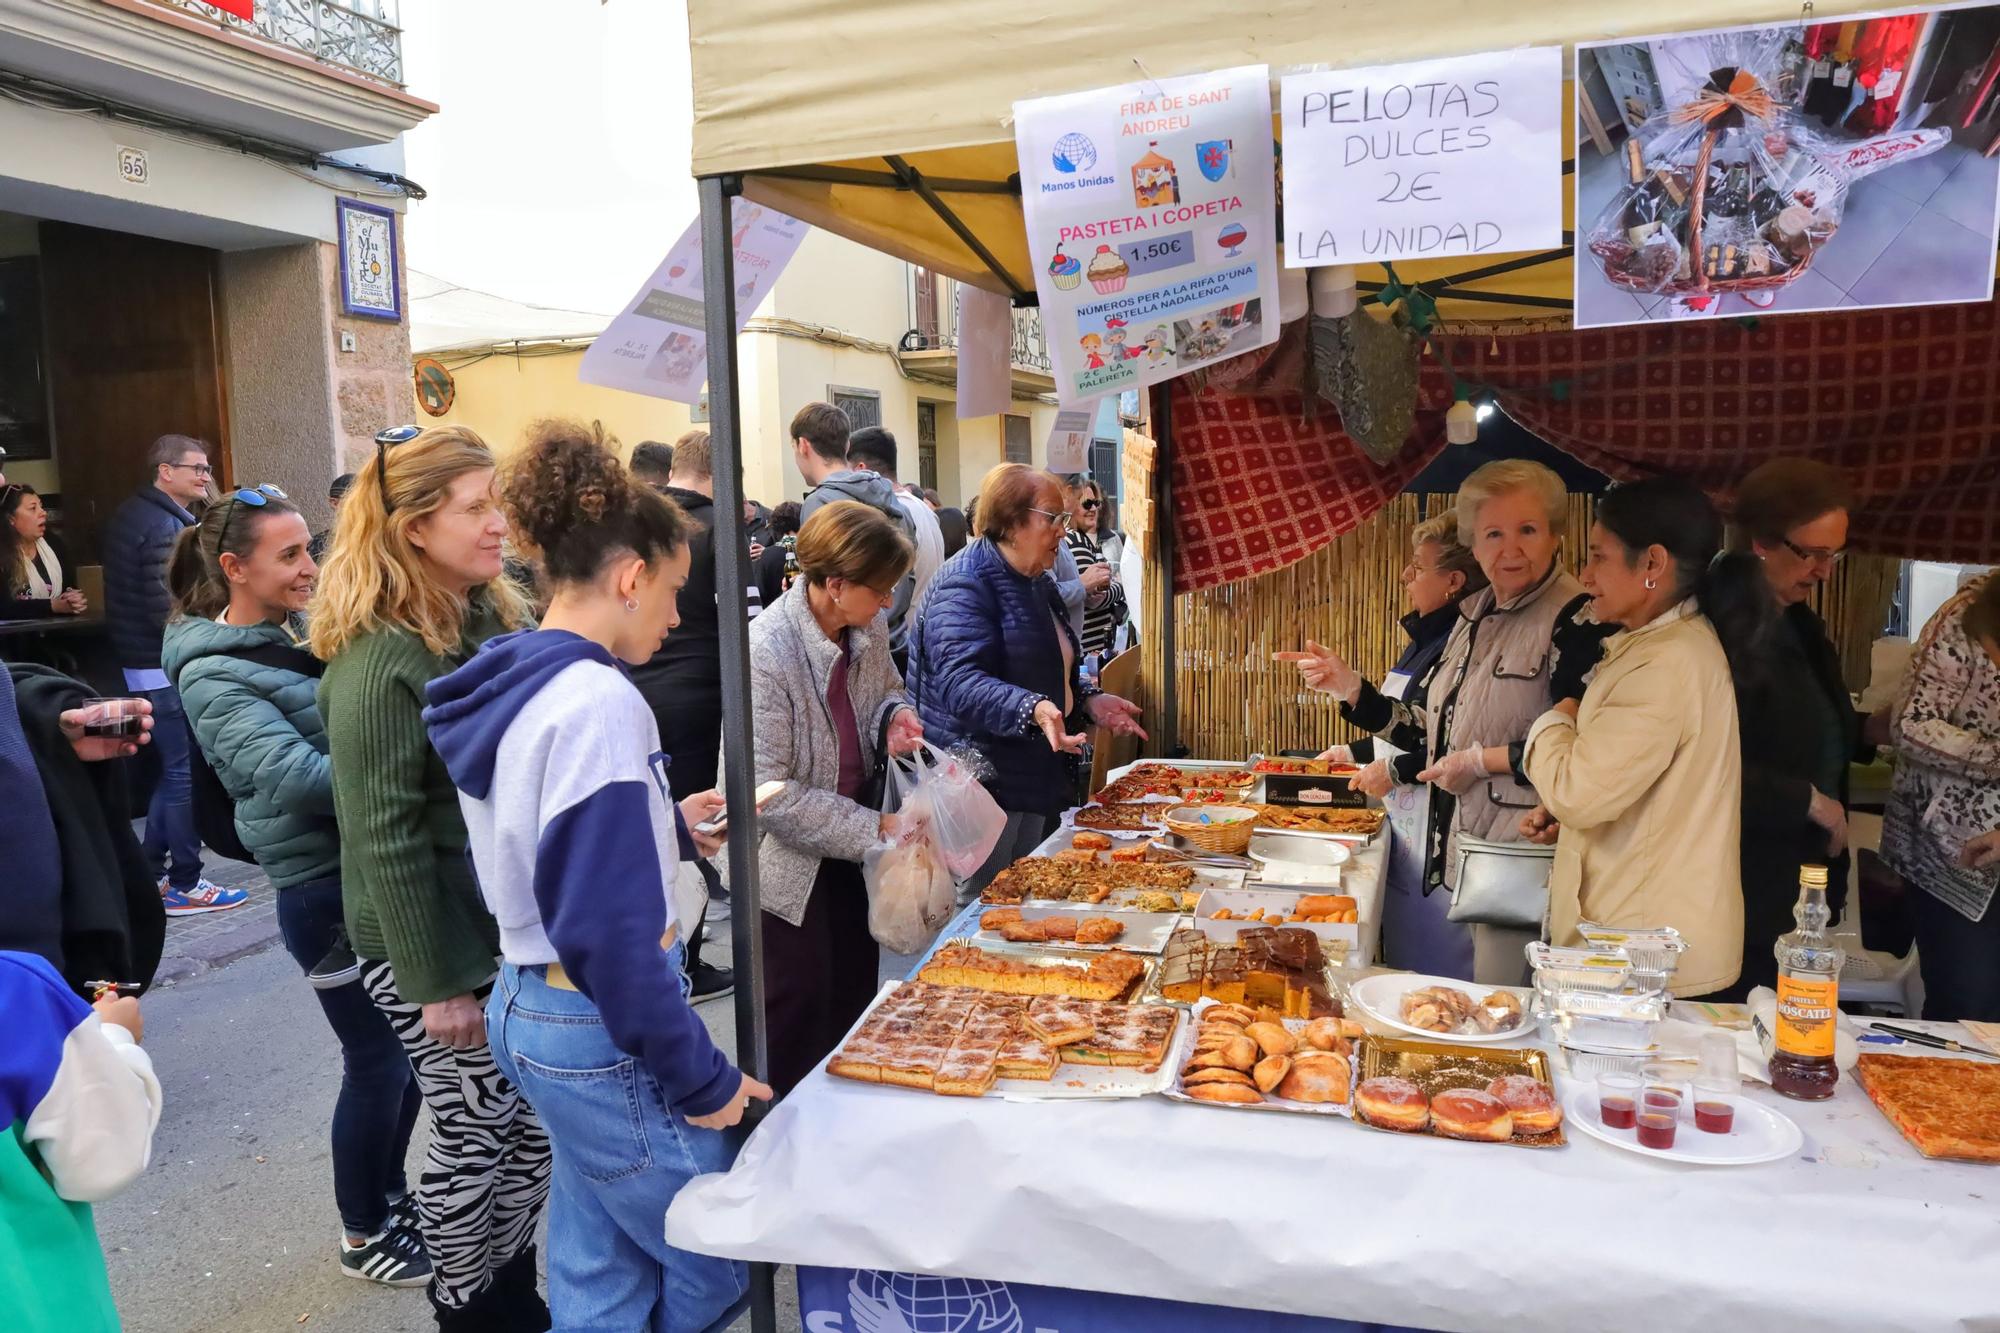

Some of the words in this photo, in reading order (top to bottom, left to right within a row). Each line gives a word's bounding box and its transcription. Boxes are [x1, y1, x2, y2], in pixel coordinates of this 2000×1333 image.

[1120, 100, 1158, 116] FIRA
[1162, 96, 1184, 112] DE
[1188, 87, 1232, 107] SANT
[1302, 81, 1500, 128] PELOTAS
[1122, 114, 1190, 136] ANDREU
[1344, 126, 1492, 168] DULCES
[123, 155, 144, 177] 55
[1041, 181, 1076, 193] Manos
[1078, 175, 1115, 188] Unidas
[1376, 171, 1443, 203] 2€
[1059, 215, 1148, 242] PASTETA
[1151, 213, 1158, 227] I
[1163, 196, 1243, 225] COPETA
[1131, 240, 1182, 262] 1,50€
[1298, 229, 1338, 260] LA
[1362, 221, 1503, 255] UNIDAD
[1077, 297, 1135, 317] NÚMEROS
[1138, 292, 1161, 304] PER
[1162, 288, 1172, 298] A
[1173, 284, 1188, 295] LA
[1190, 277, 1215, 290] RIFA
[1217, 265, 1253, 283] D'UNA
[1104, 303, 1159, 322] CISTELLA
[1160, 284, 1230, 309] NADALENCA
[1079, 369, 1133, 389] PALERETA
[1109, 363, 1124, 372] LA
